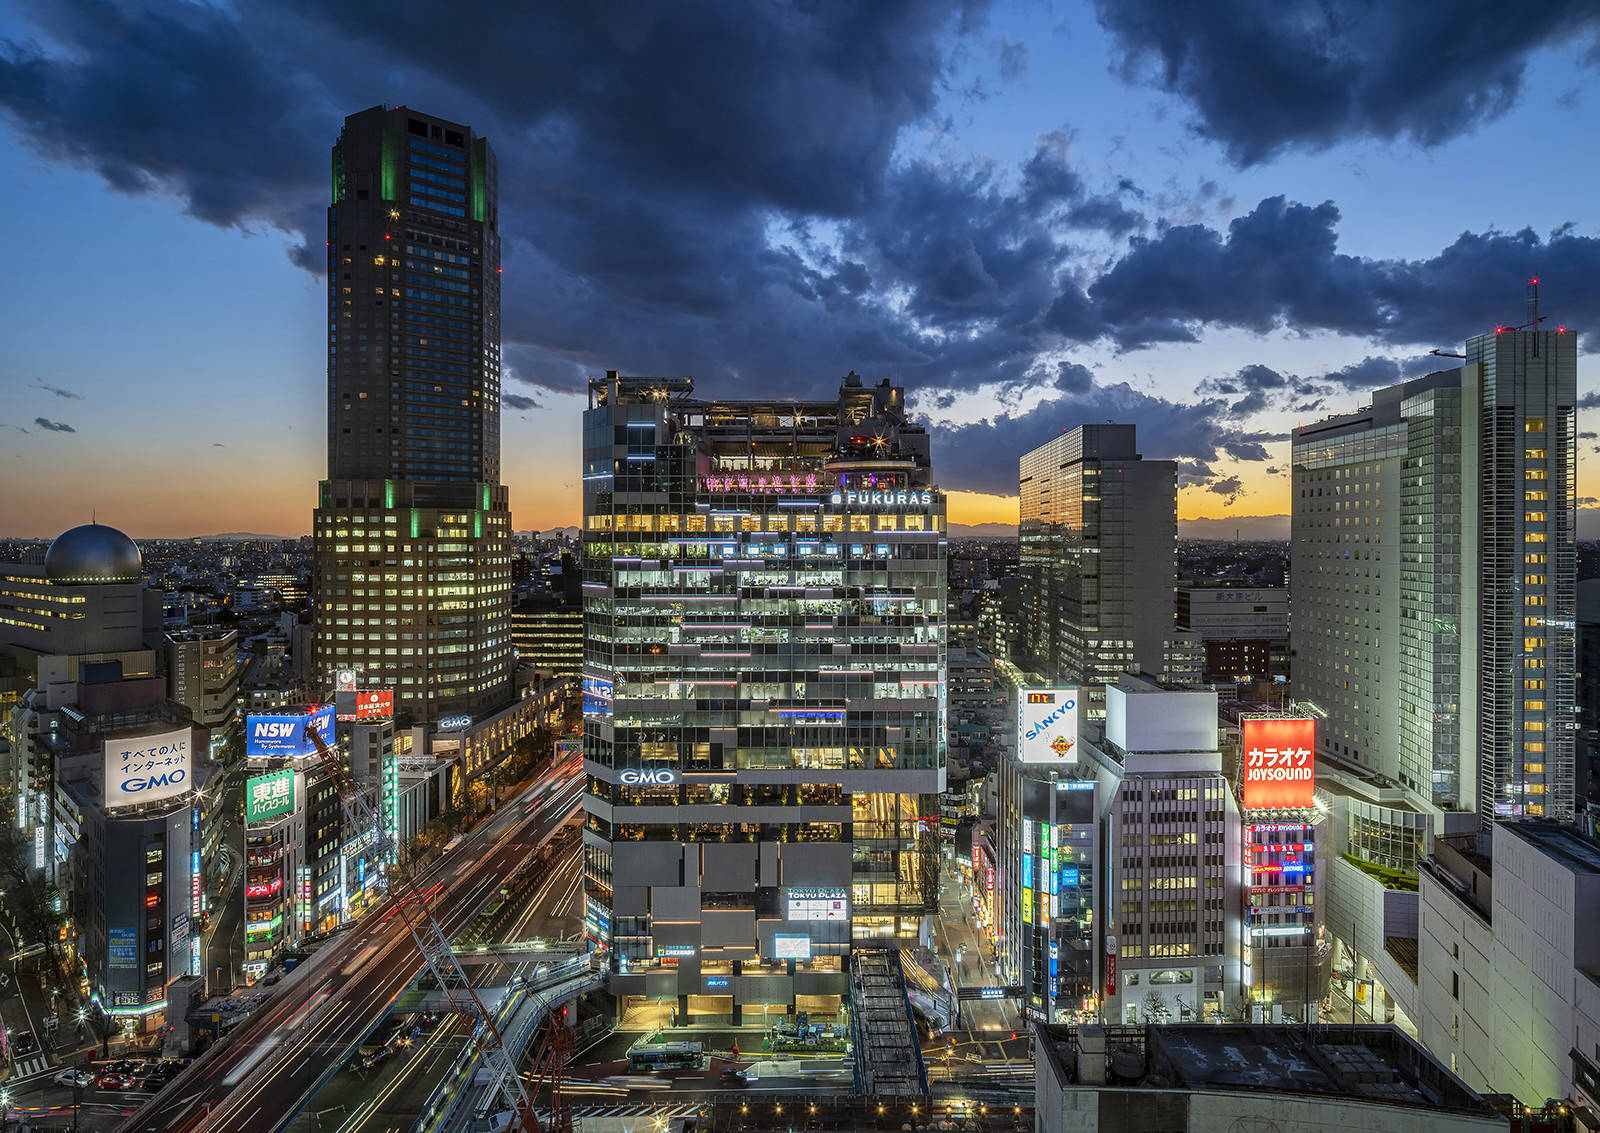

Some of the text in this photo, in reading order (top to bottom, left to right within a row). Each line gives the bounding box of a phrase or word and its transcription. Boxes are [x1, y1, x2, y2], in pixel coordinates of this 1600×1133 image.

[847, 494, 931, 504] FUKURAS
[440, 717, 470, 728] GMO
[1025, 699, 1075, 741] SANKYO
[254, 723, 295, 737] NSW
[120, 741, 186, 761] すべての人に
[1248, 747, 1311, 767] カラオケ
[120, 753, 186, 773] インターネット
[120, 769, 186, 792] GMO
[620, 769, 674, 784] GMO
[1247, 767, 1312, 782] JOYSOUND
[252, 777, 290, 805] 東進
[252, 796, 290, 815] ハイスクール
